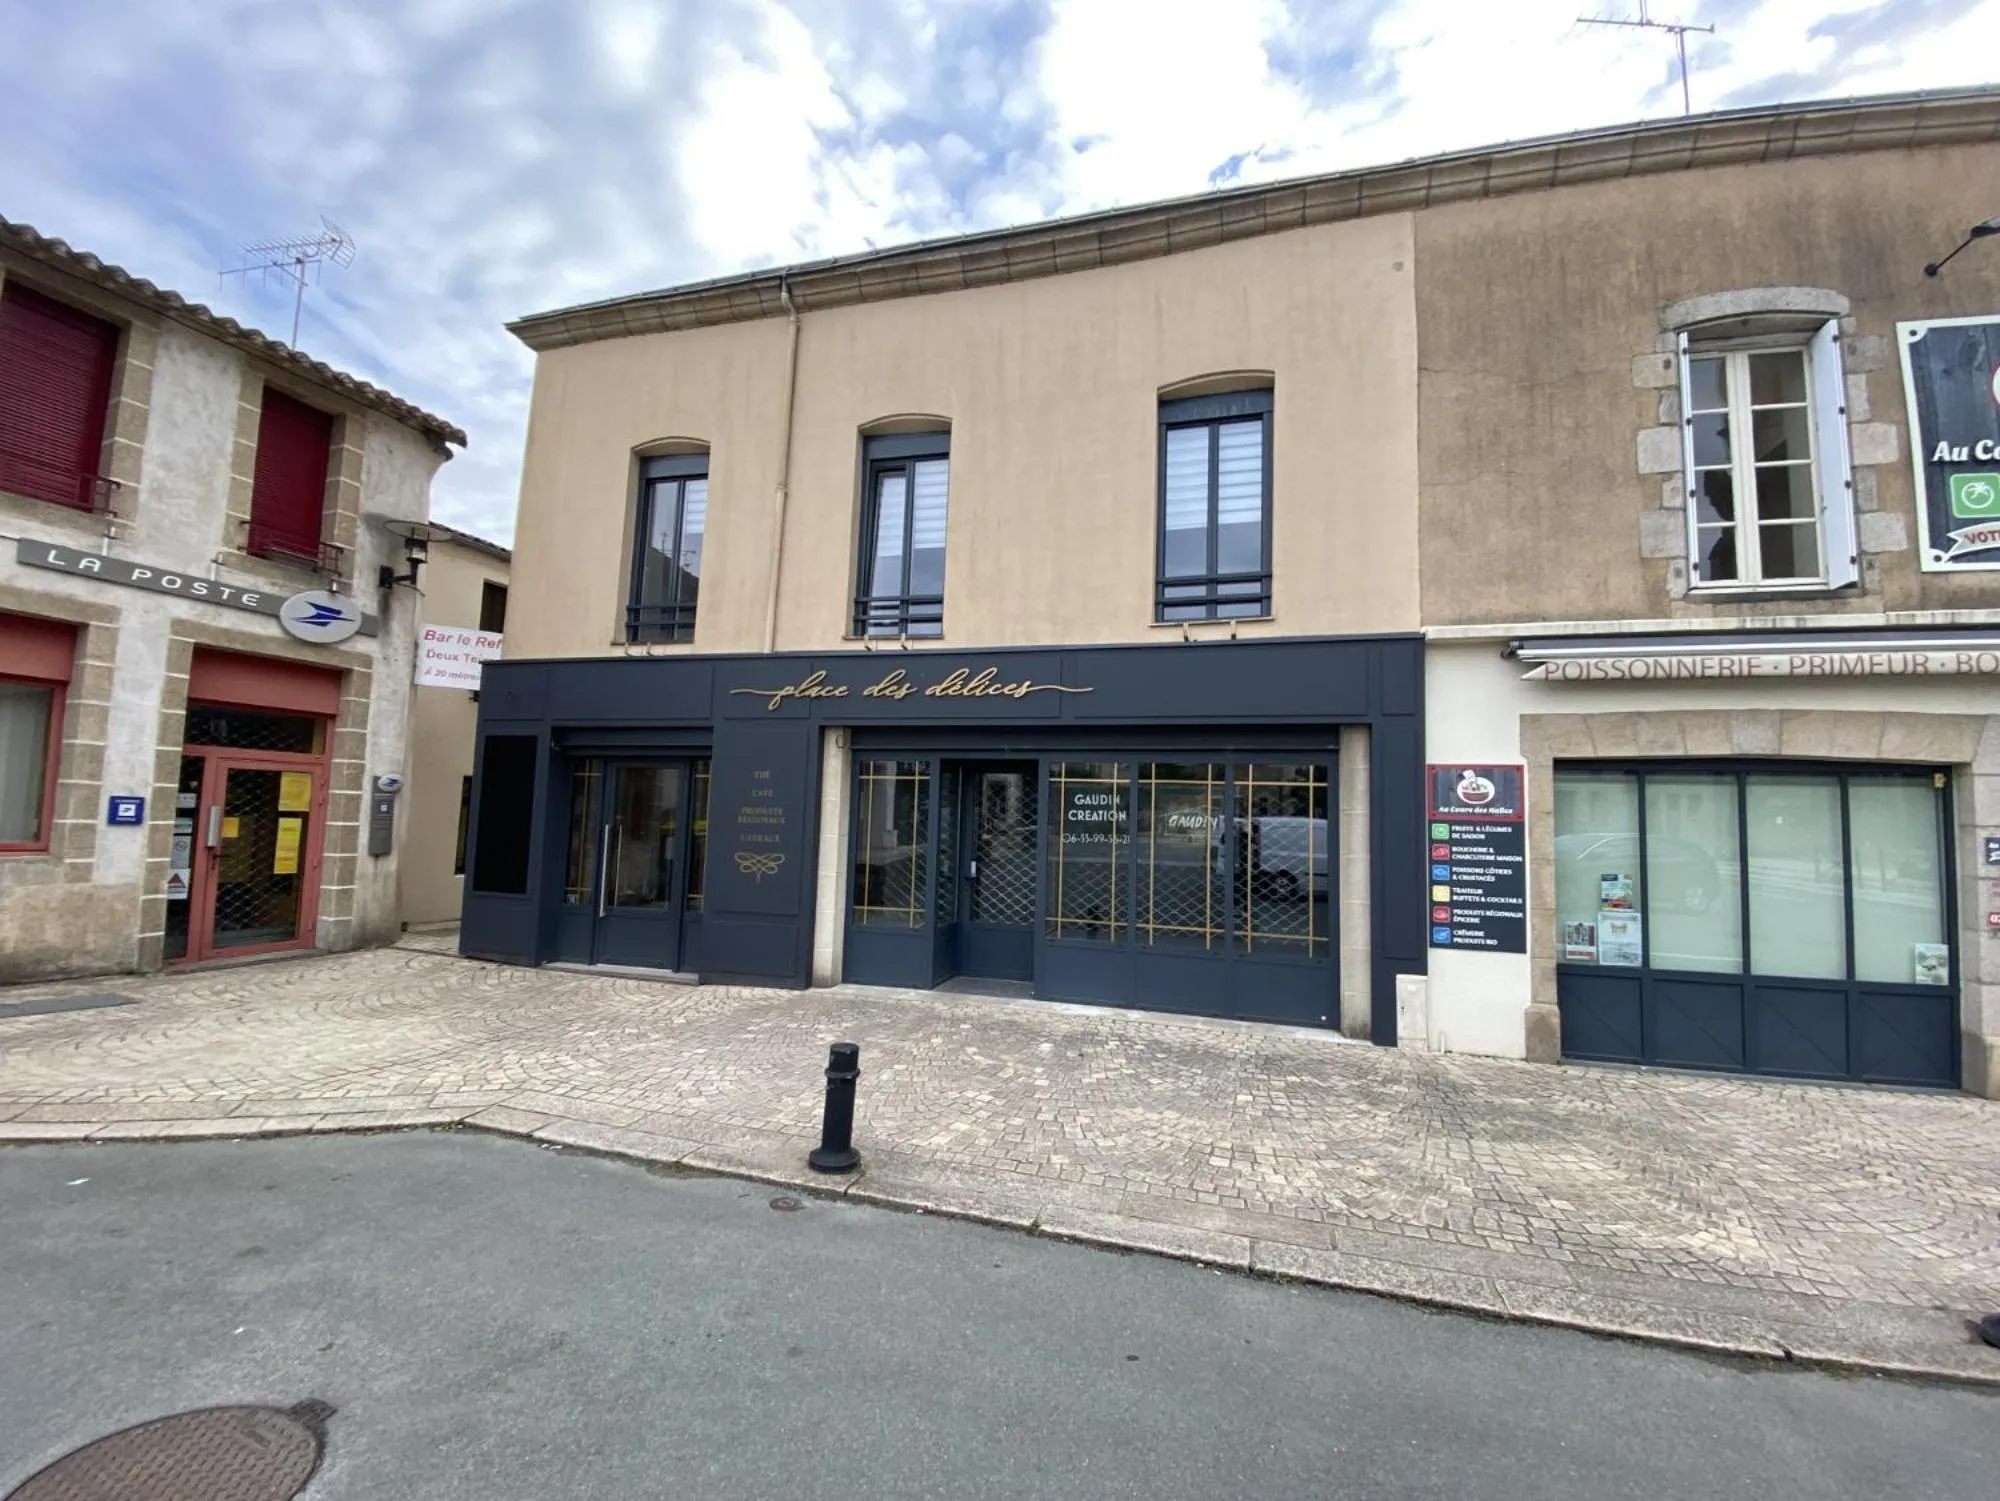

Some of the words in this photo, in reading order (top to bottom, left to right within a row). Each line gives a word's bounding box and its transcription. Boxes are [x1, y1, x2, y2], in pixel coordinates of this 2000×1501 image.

[1932, 440, 1969, 462] Au
[1964, 530, 2000, 545] VOT
[47, 549, 101, 572] LA
[131, 568, 260, 607] POSTE
[424, 629, 454, 643] Bar
[457, 634, 471, 645] le
[426, 648, 460, 661] Deux
[1544, 656, 1762, 680] POISSONNERIE
[1788, 653, 1929, 676] PRIMEUR
[730, 669, 848, 711] place
[862, 668, 918, 699] des
[925, 666, 1094, 698] délices
[1074, 794, 1120, 805] GAUDIN
[1068, 809, 1127, 821] CREATION
